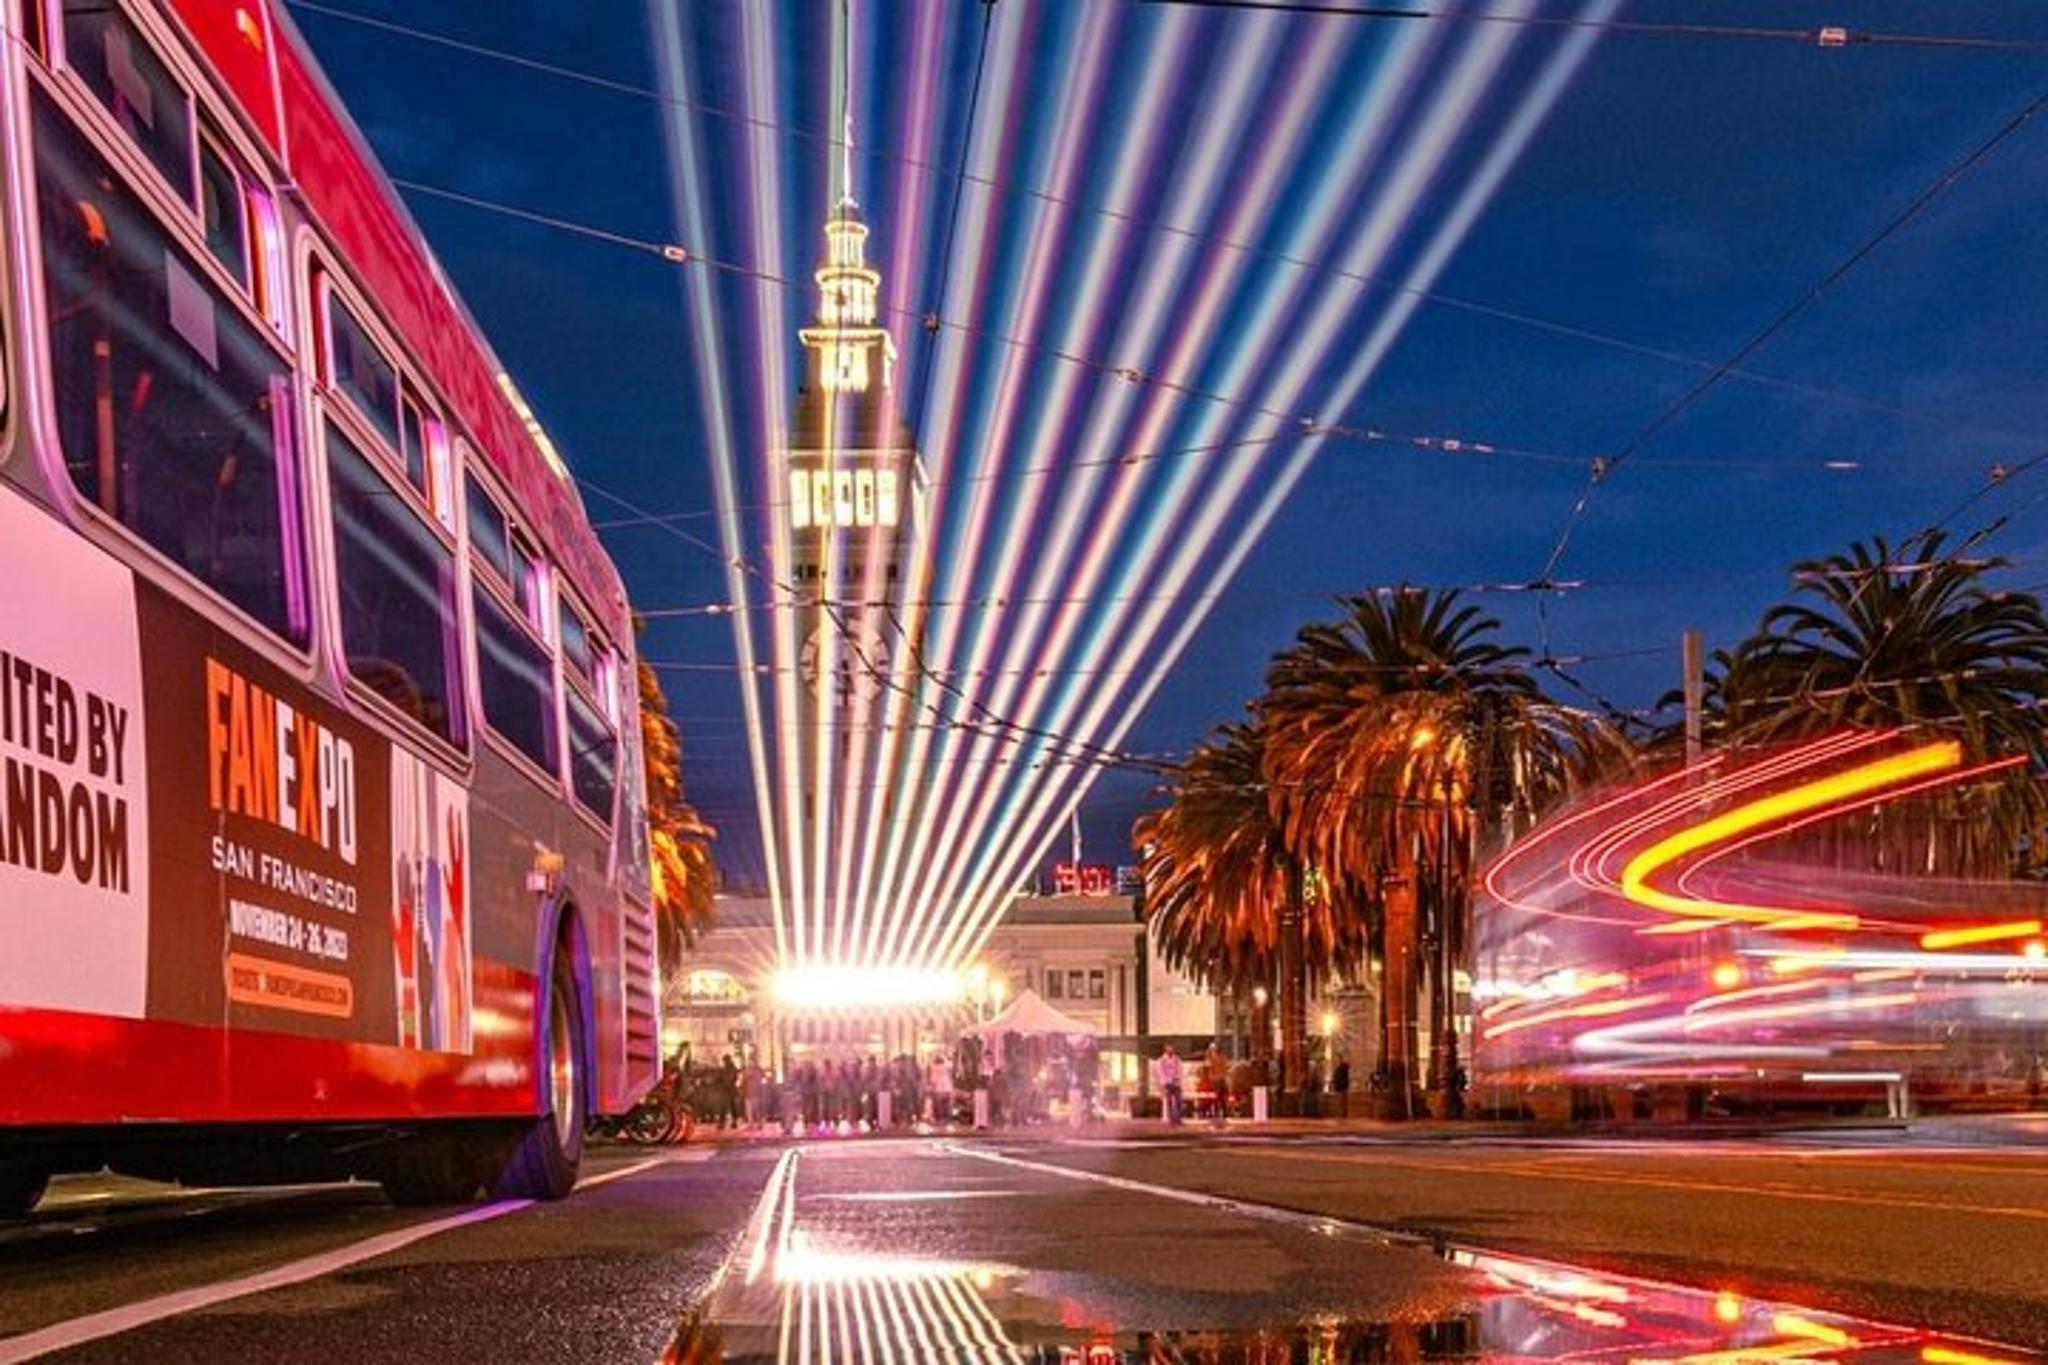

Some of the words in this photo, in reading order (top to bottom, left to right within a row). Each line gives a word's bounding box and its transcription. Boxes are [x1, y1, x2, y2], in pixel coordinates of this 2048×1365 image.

[87, 692, 127, 786] BY
[0, 756, 129, 894] NDOM
[212, 836, 254, 881] SAN
[261, 853, 357, 914] FRANCISCO
[230, 899, 288, 947] NOVEMBER
